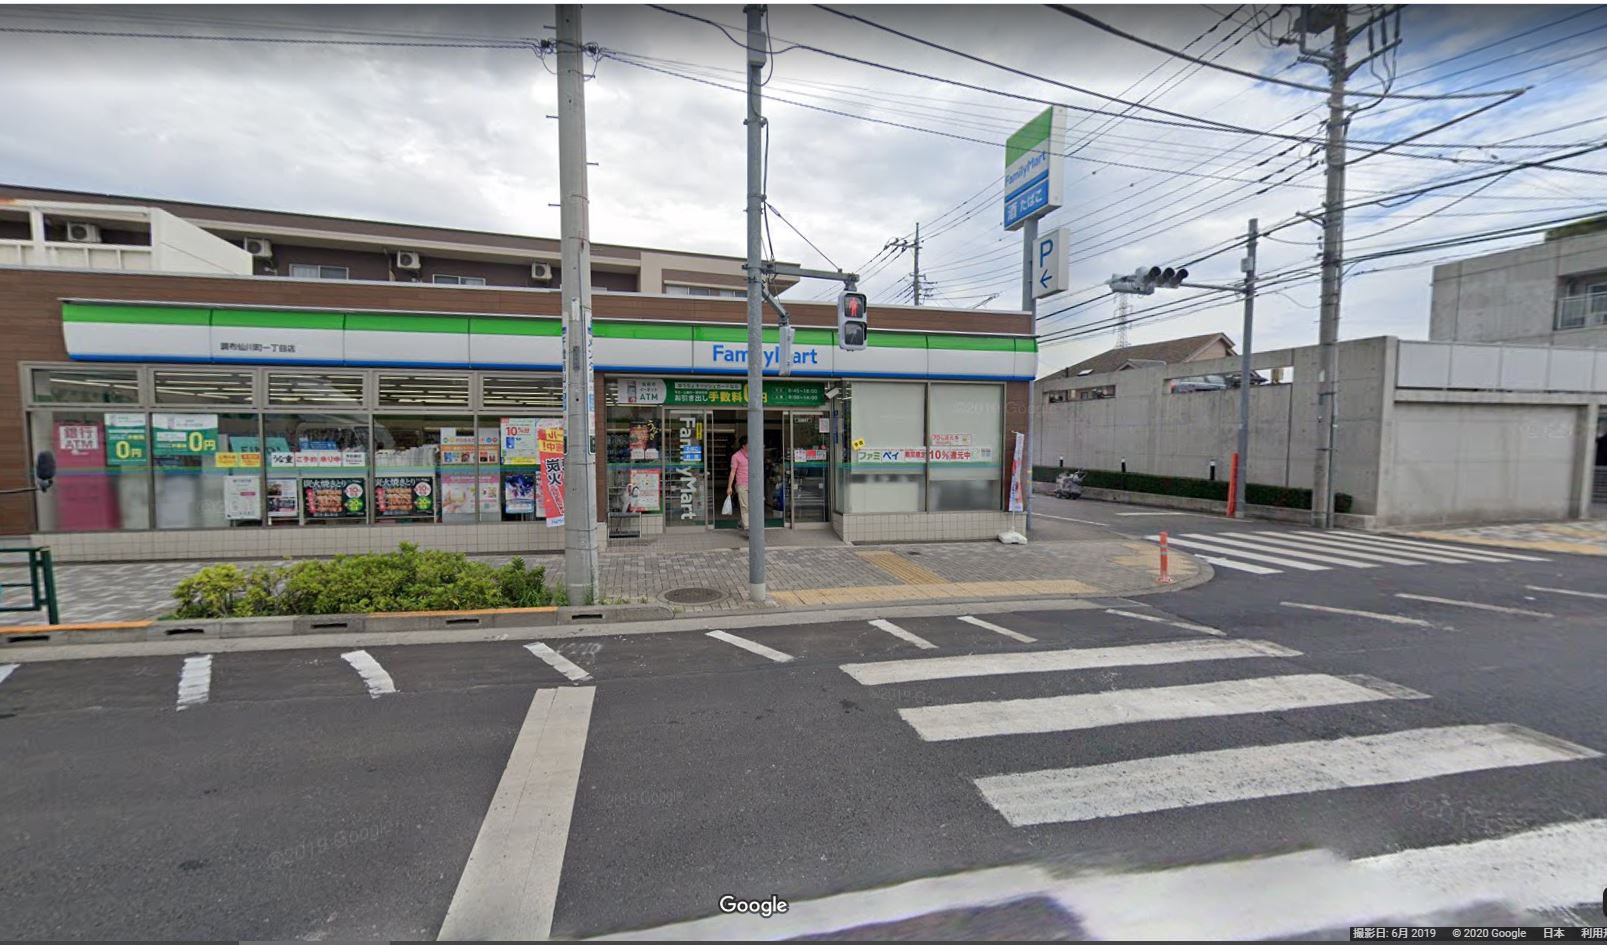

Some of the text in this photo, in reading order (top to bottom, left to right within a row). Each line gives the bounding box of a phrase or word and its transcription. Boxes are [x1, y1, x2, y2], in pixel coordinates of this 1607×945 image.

[1005, 151, 1046, 187] FamilyMart
[1040, 240, 1053, 268] P
[713, 344, 818, 367] Famyart
[640, 393, 658, 401] ATM
[188, 431, 216, 451] 0円
[859, 451, 899, 460] ファミペイ
